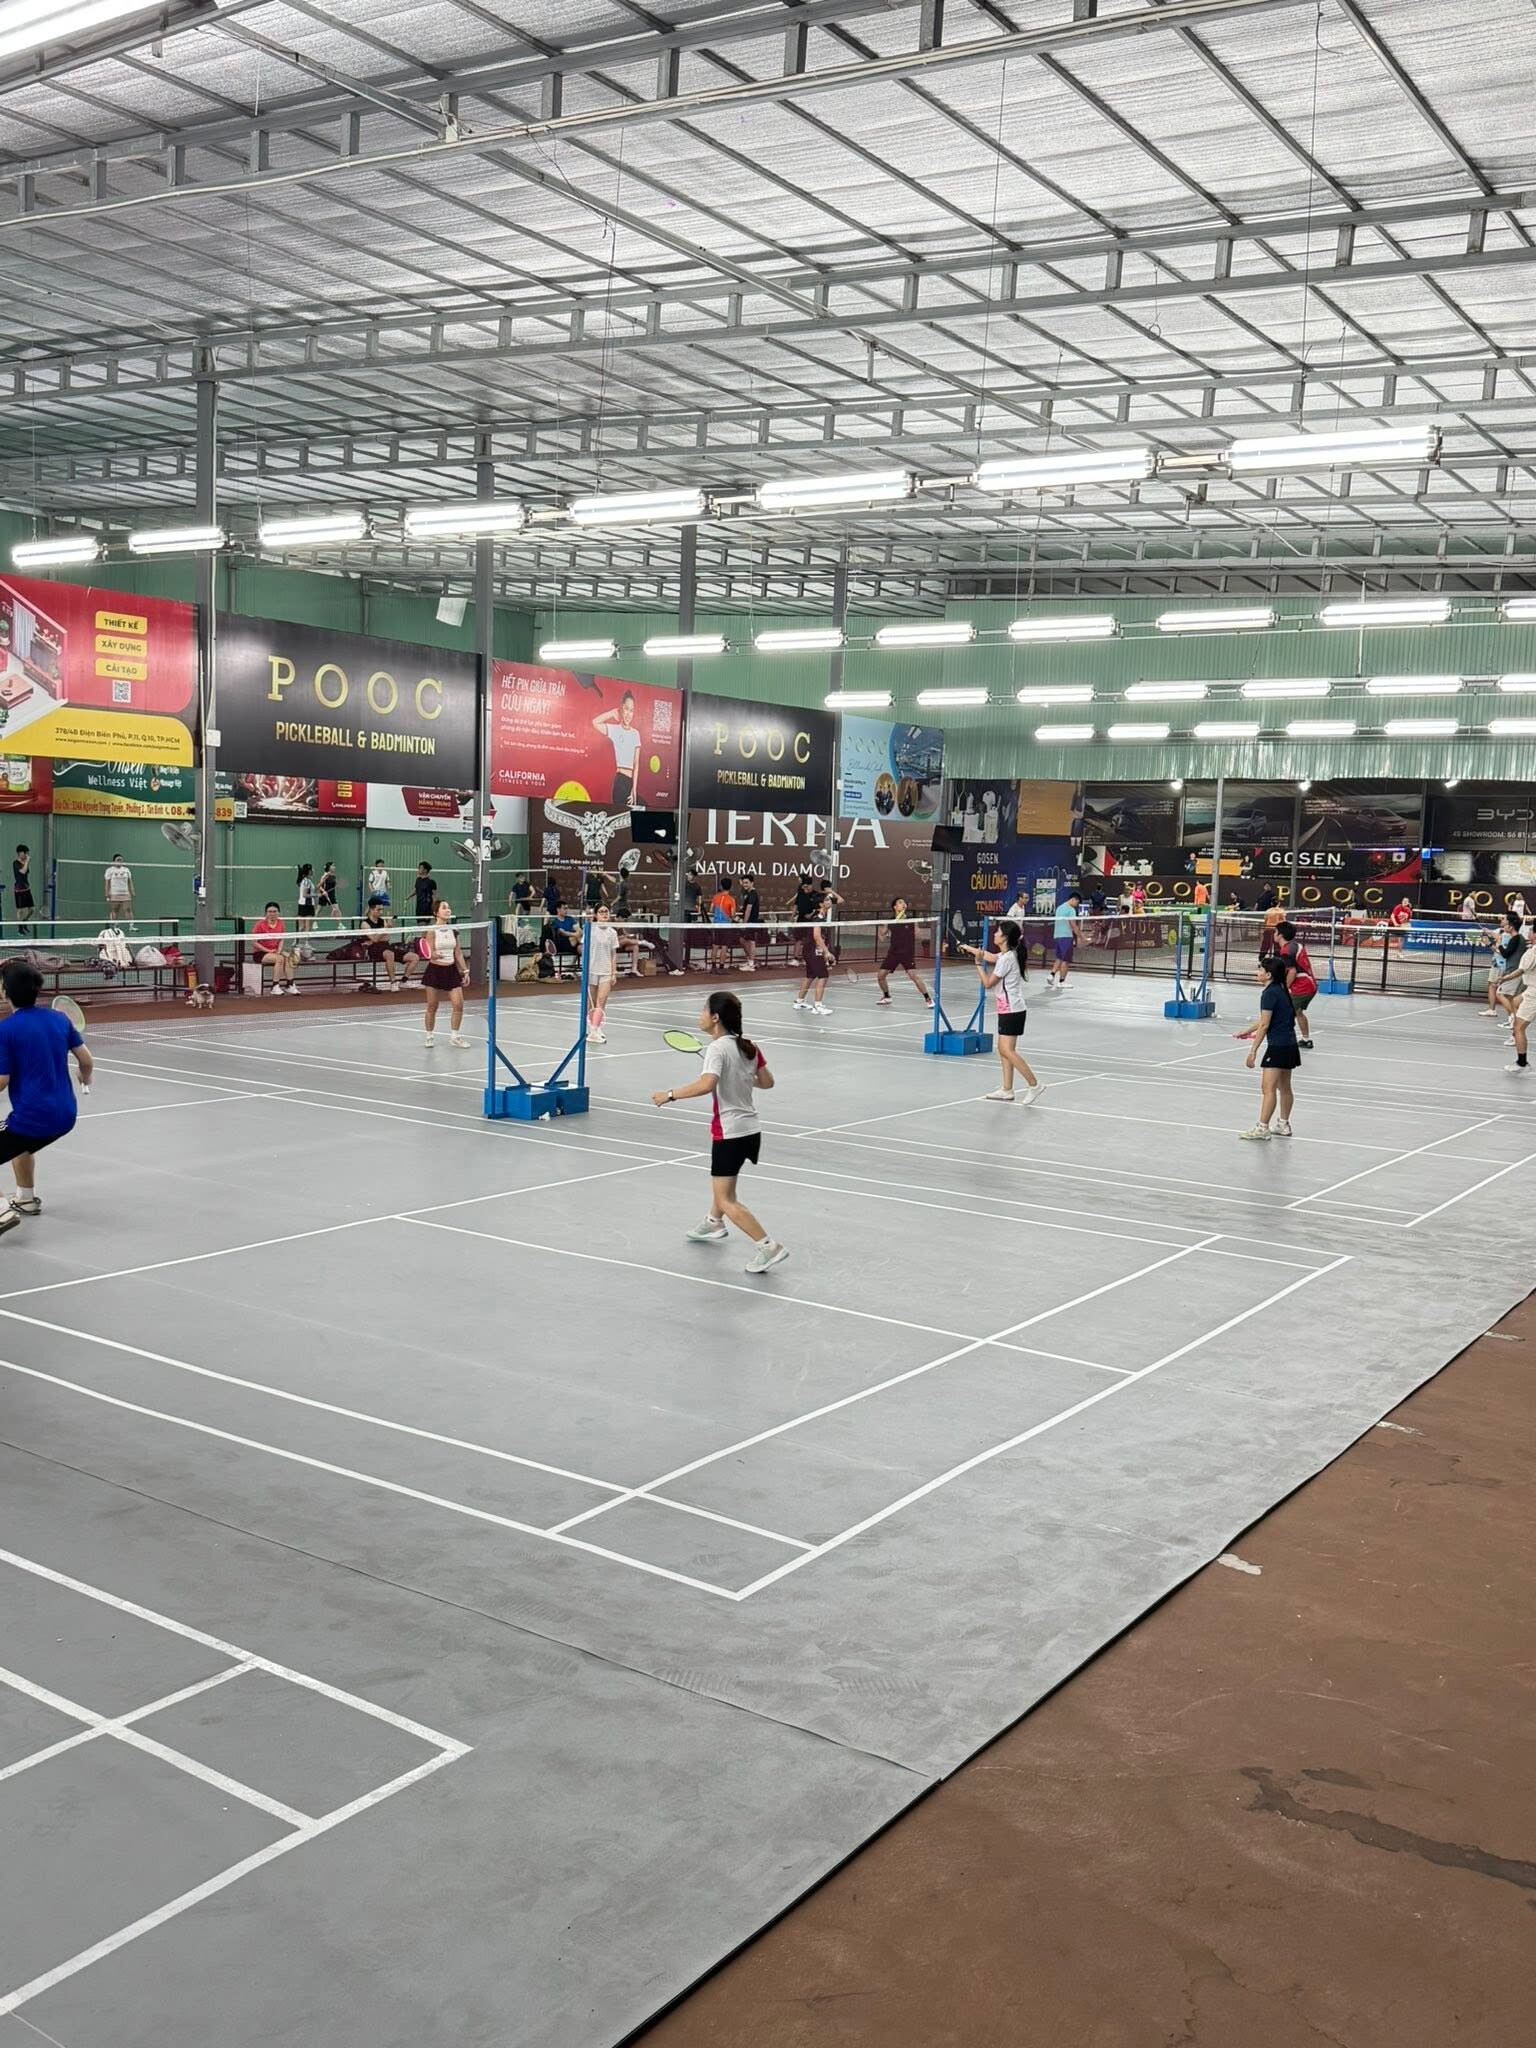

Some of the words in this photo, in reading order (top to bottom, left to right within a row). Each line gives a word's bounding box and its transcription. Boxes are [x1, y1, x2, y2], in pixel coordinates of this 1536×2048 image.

[267, 655, 443, 720] POOC
[276, 721, 353, 747] PICKLEBALL
[357, 731, 367, 749] &
[371, 732, 436, 756] BADMINTON
[713, 722, 811, 764] POOC
[88, 775, 126, 788] Wellness
[129, 777, 148, 791] Việt
[499, 769, 546, 781] CALIFORNIA
[717, 769, 759, 787] PICKLEBALL
[761, 773, 767, 787] &
[768, 774, 806, 790] BADMINTON
[1477, 808, 1535, 821] BYD
[1462, 830, 1506, 838] SHOWROOM:
[976, 853, 999, 864] GOSEN
[1269, 851, 1341, 866] GOSEN
[695, 860, 766, 876] NATURAL
[772, 862, 850, 879] DIAMOD
[971, 867, 987, 890] CẦU
[988, 870, 1008, 890] LÔNG
[1276, 885, 1384, 903] POOC
